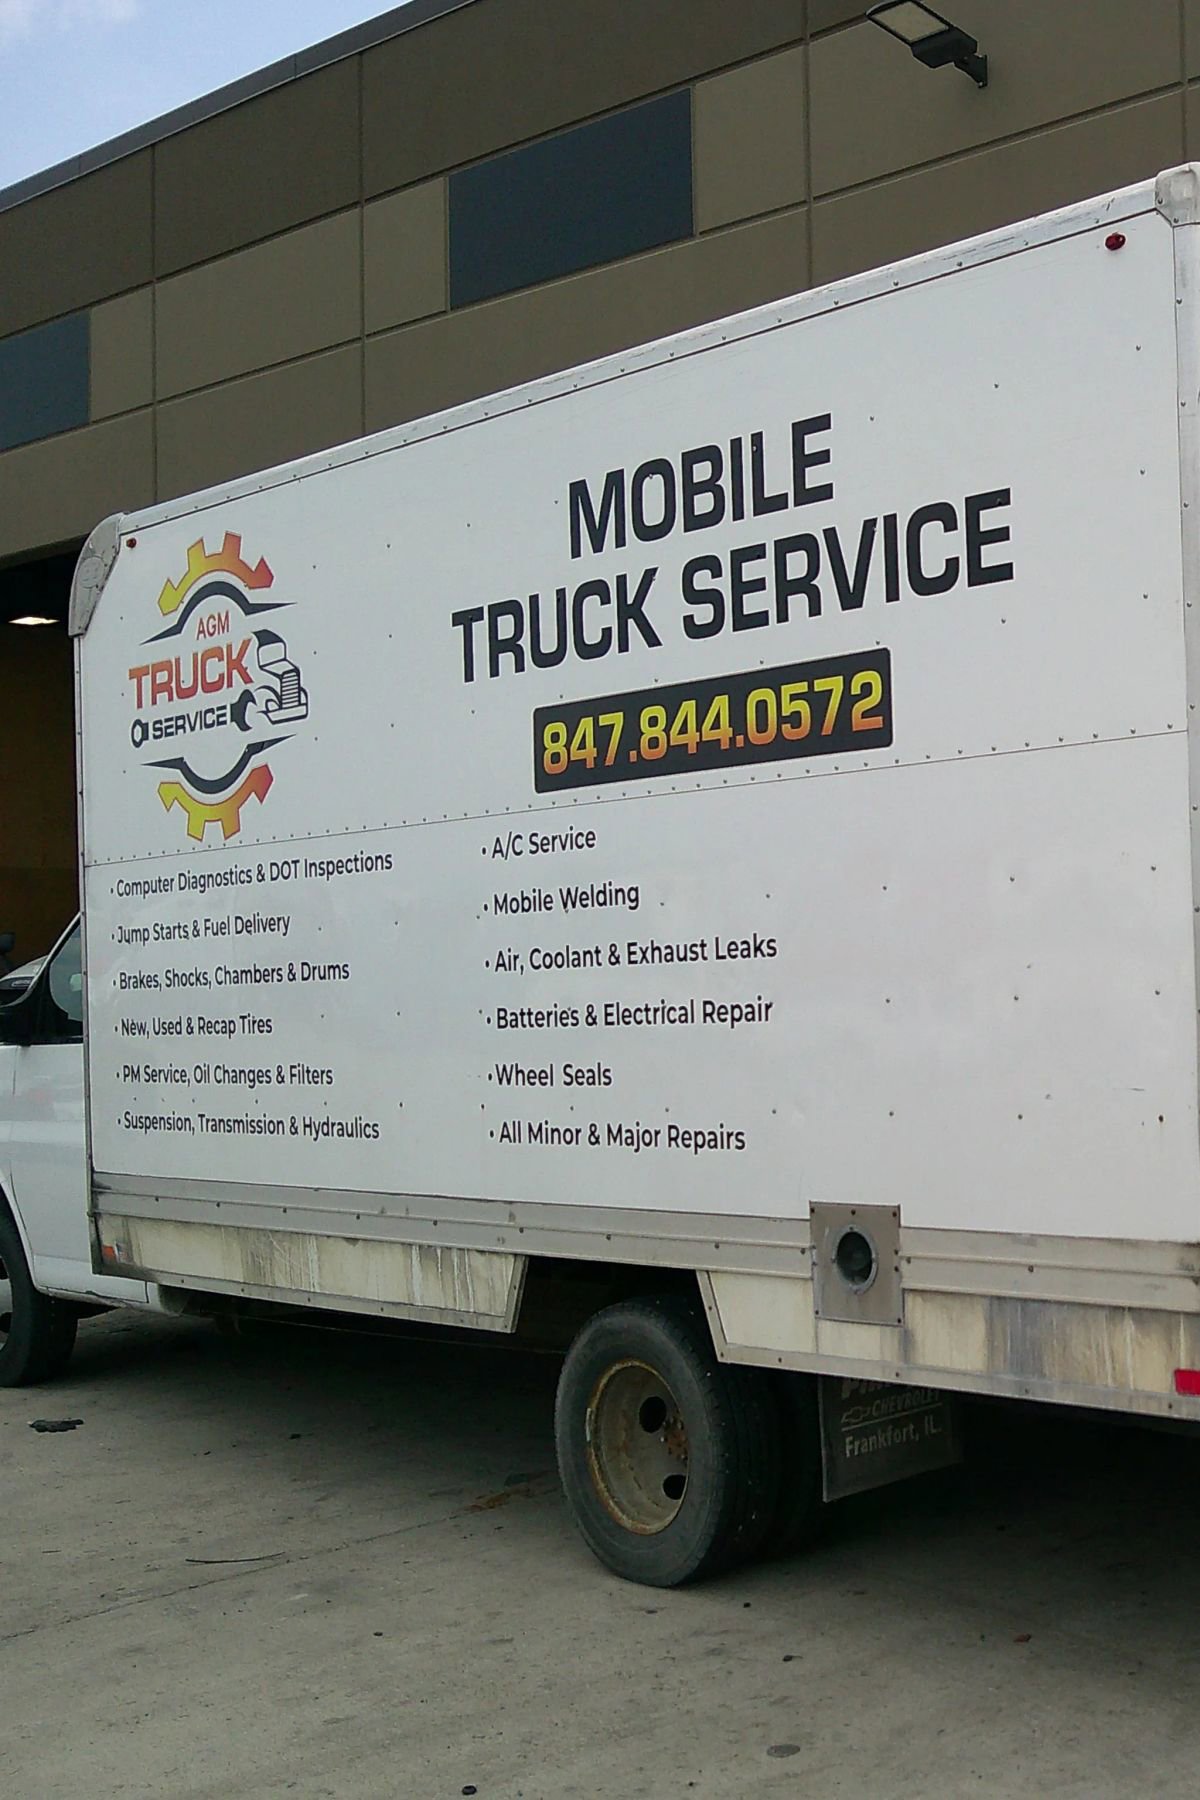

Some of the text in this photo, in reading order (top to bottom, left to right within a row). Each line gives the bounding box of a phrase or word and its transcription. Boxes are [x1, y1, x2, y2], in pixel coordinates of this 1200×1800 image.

[570, 413, 833, 558] MOBILE
[452, 489, 1014, 682] TRUCK SERVICE
[197, 610, 229, 640] AGM
[128, 638, 254, 709] TRUCK
[152, 705, 227, 740] SERVICE
[543, 670, 882, 774] 847.844.0572
[492, 826, 596, 860] A/C Service
[117, 851, 393, 898] Computer Diagnostics & DOT Inspections
[494, 881, 639, 915] Mobile Welding
[117, 913, 290, 946] Jump Starts & Fuel Delivery
[495, 933, 777, 975] Air, Coolant & Exhaust Leaks
[120, 961, 349, 991] Brakes, Shocks, Chambers & Drums
[121, 1014, 272, 1039] New, Used & Recap Tires
[497, 995, 773, 1029] Batteries & Electrical Repair
[123, 1064, 333, 1088] PM Service, Oil Changes & Filters
[496, 1062, 612, 1086] Wheel Seals
[124, 1111, 379, 1141] Suspension, Transmission & Hydraulics
[500, 1120, 745, 1154] All Minor & Major Repairs
[845, 1424, 919, 1459] Frankfort,
